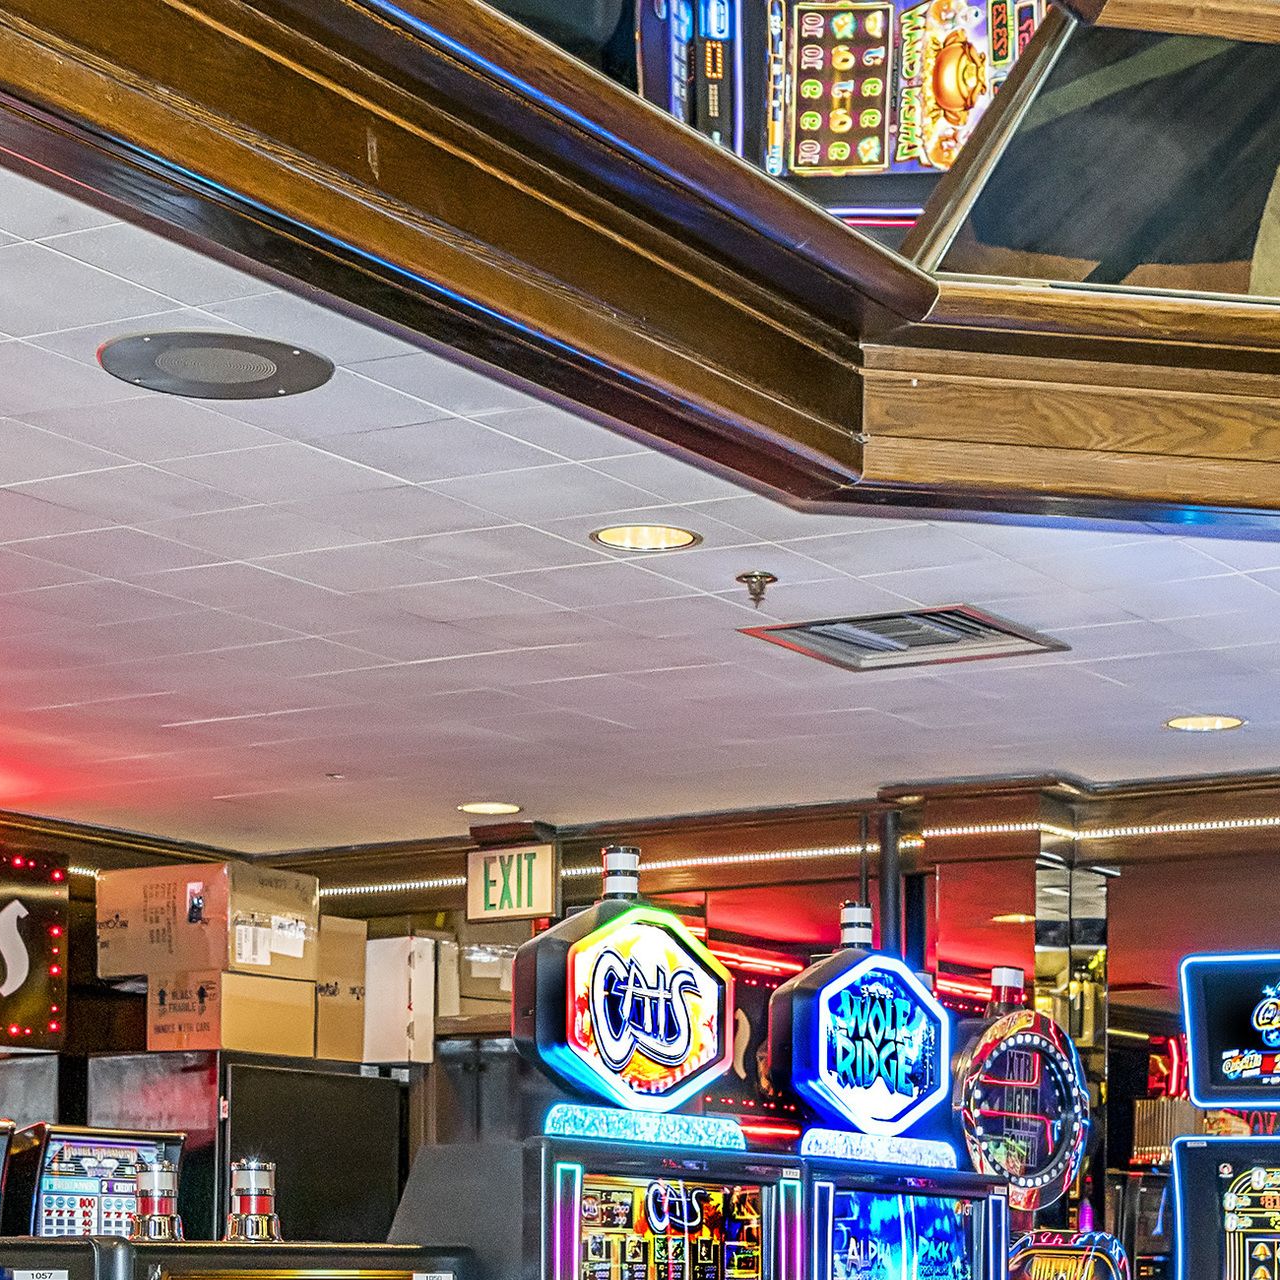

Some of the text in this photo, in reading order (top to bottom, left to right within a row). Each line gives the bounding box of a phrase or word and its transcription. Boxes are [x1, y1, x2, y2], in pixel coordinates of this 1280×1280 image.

[483, 851, 537, 912] EXIT
[837, 1033, 914, 1098] RIDGE
[919, 1236, 949, 1260] PACK
[30, 1272, 53, 1280] 1057
